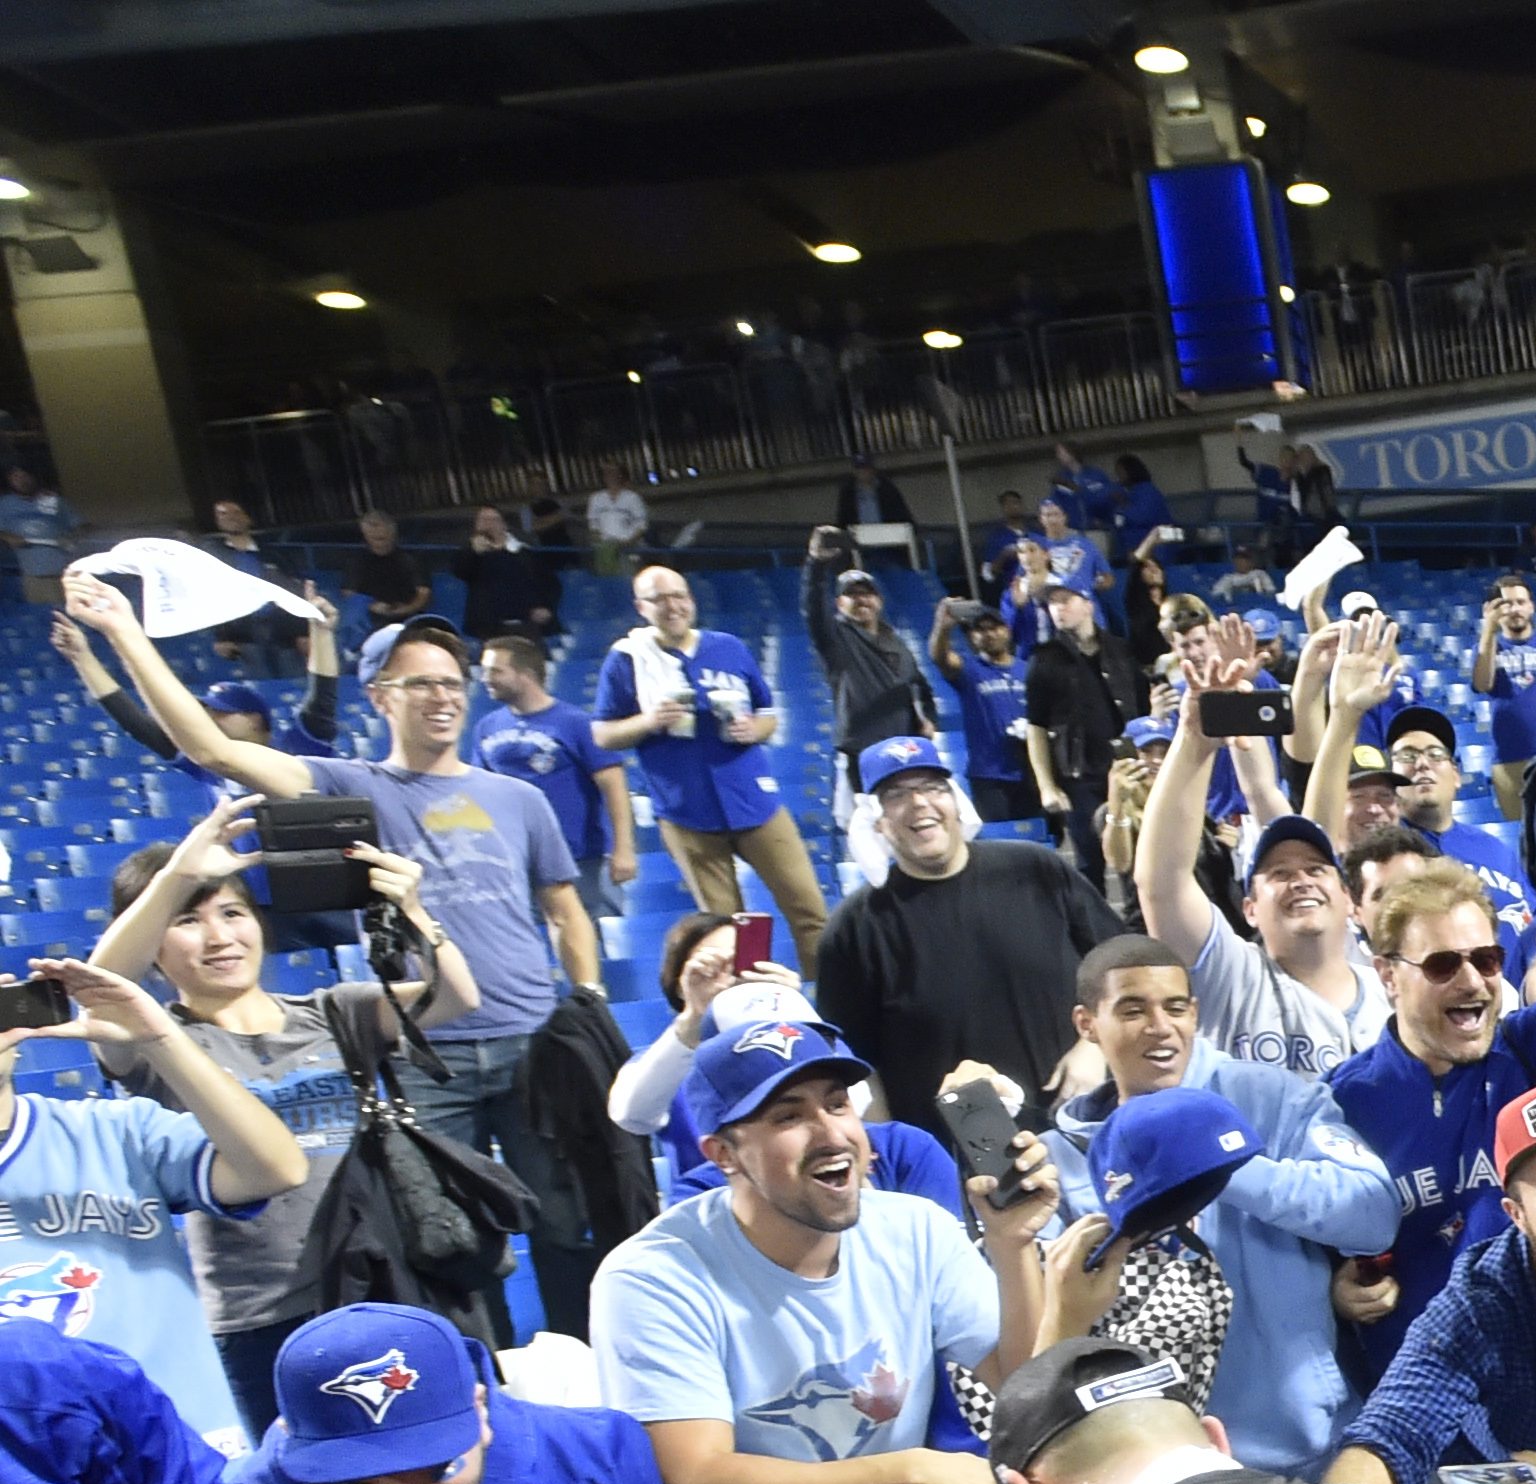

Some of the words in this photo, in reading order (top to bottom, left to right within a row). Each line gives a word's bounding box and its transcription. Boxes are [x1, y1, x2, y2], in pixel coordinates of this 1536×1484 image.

[1395, 1166, 1444, 1217] UE
[1454, 1148, 1503, 1194] JA
[31, 1189, 162, 1241] JAYS
